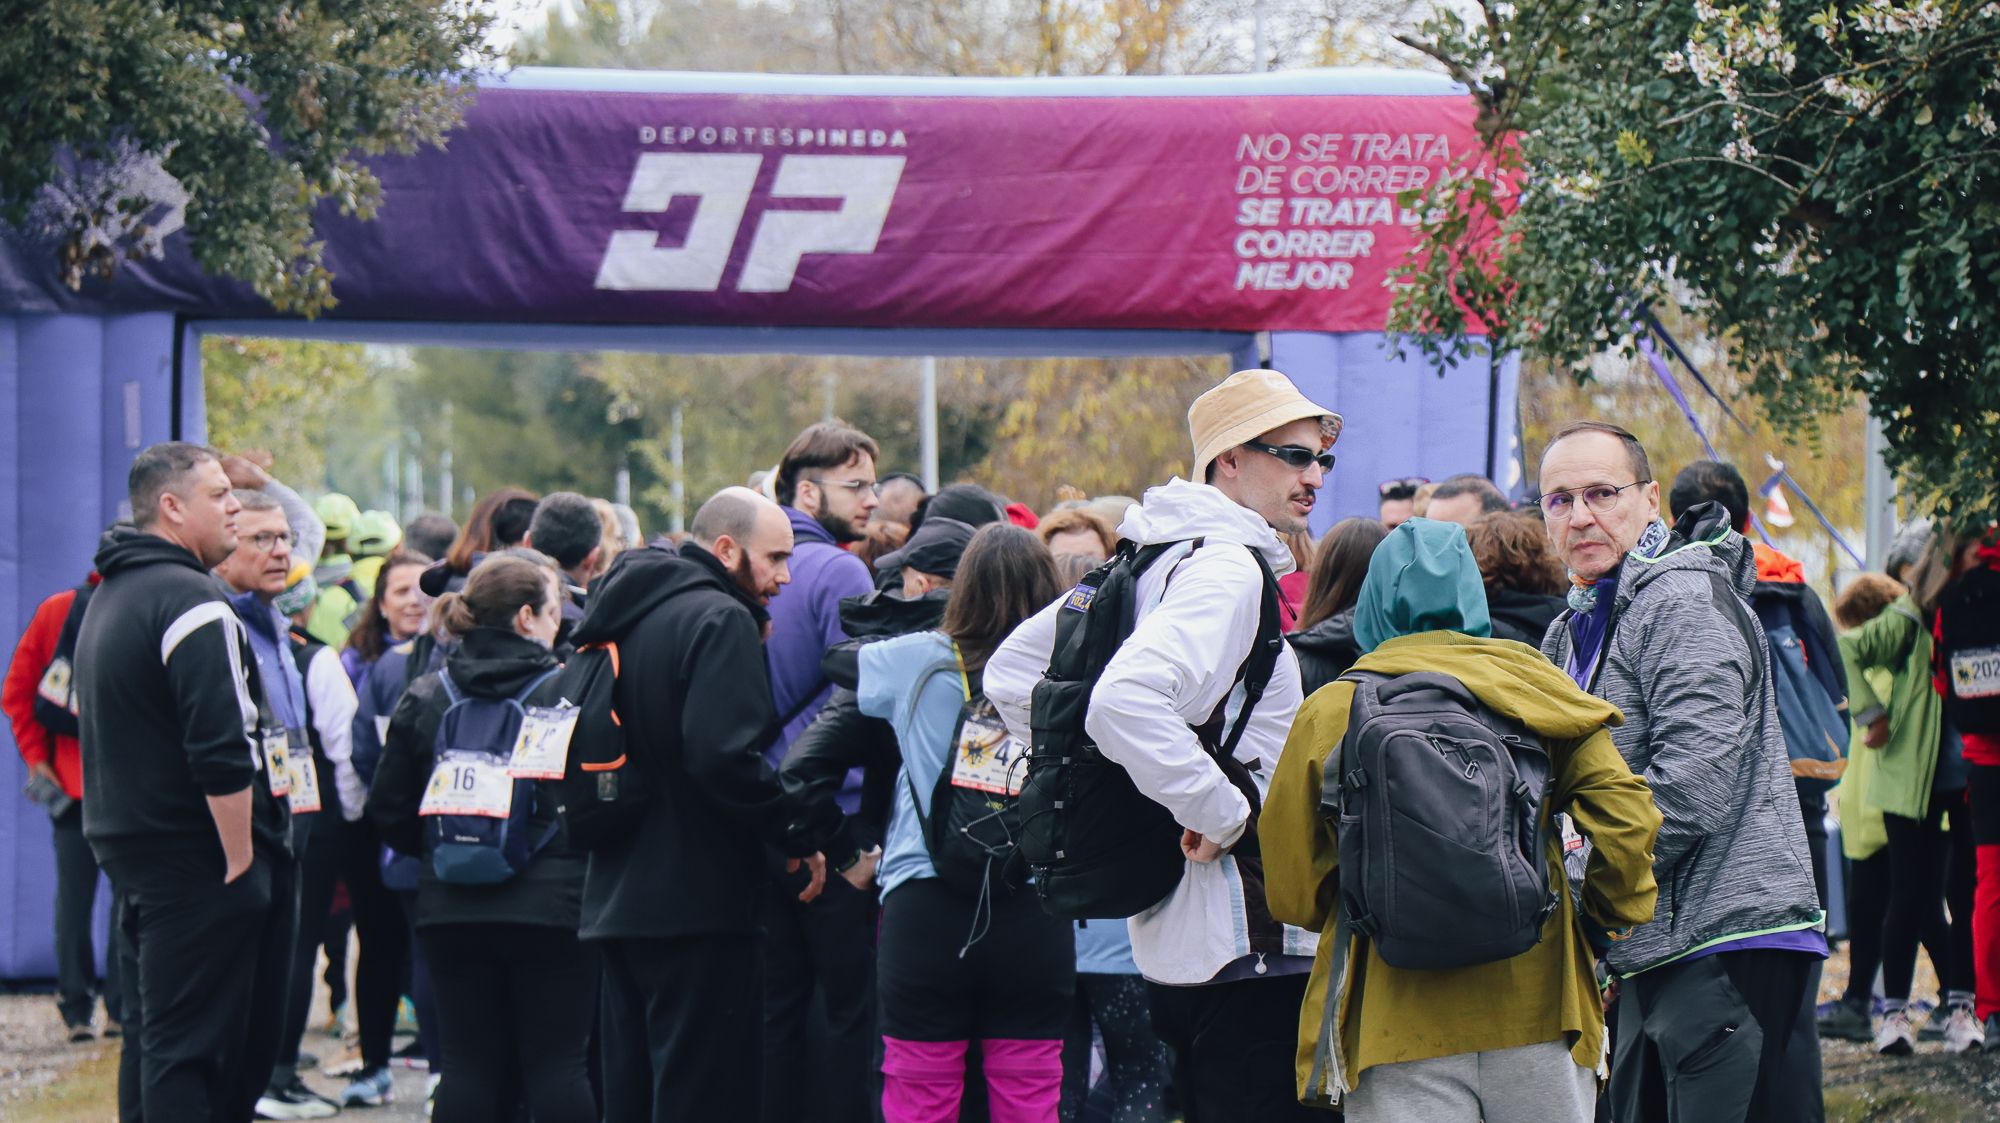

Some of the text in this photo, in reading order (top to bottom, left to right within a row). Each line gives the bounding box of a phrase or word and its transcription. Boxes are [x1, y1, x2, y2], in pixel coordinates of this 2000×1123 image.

[1235, 133, 1450, 162] NO SE TRATA
[1235, 165, 1287, 194] DE
[1290, 165, 1431, 194] CORRER
[1235, 197, 1284, 226] SE
[1288, 197, 1394, 226] TRATA
[1234, 229, 1376, 258] CORRER
[1234, 261, 1354, 291] MEJOR
[453, 766, 476, 791] 16
